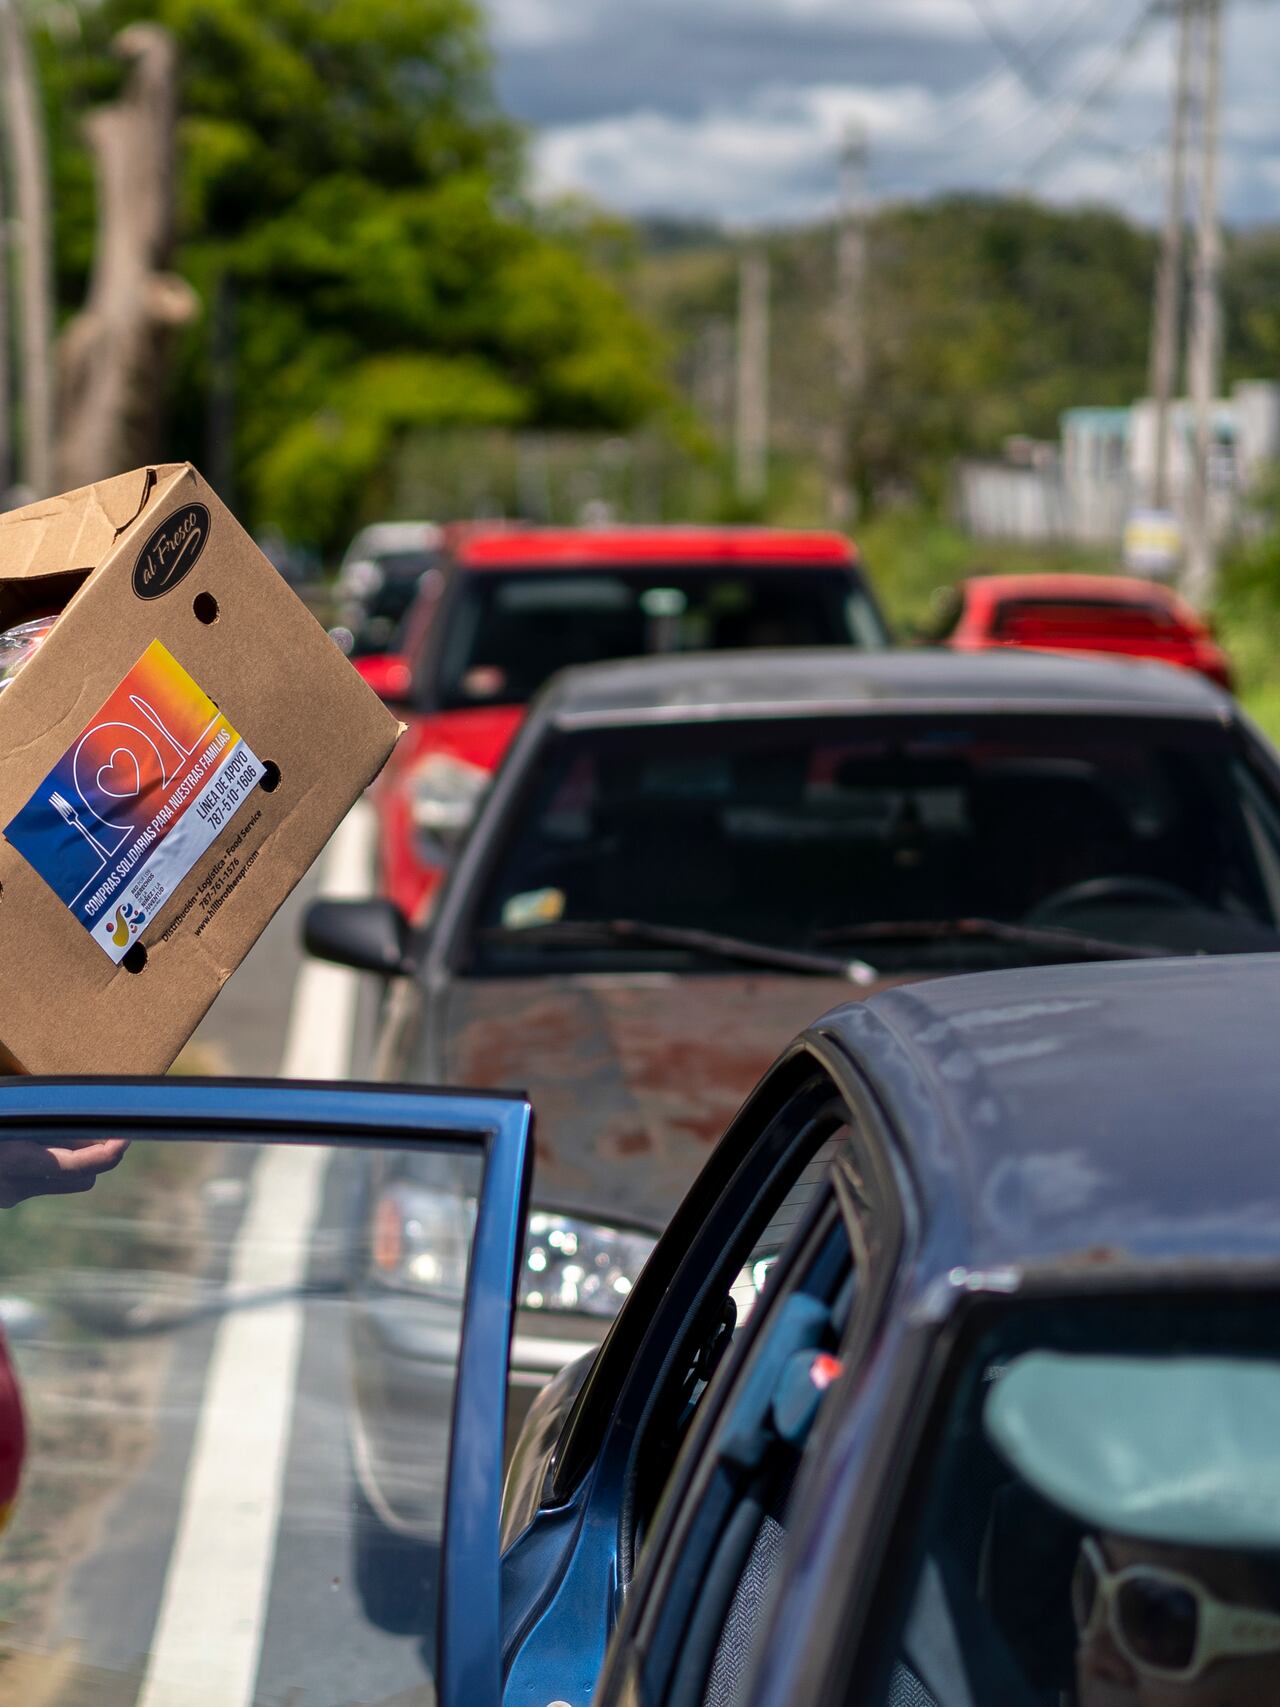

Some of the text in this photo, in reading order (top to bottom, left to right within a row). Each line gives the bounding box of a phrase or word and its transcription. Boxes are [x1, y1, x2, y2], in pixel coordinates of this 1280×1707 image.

[153, 512, 197, 565] Fresco
[196, 750, 248, 820] LÍNEA DE APOYO
[207, 765, 257, 830] 787-510-1606
[84, 728, 231, 917] COMPRAS SOLIDARIAS PARA NUESTRAS FAMILIAS
[134, 872, 154, 899] DERECHOS
[144, 886, 165, 912] JUVENTUD
[162, 810, 262, 943] Distribución Logística Food Service
[194, 850, 260, 938] www.hillbrotherspr.com
[199, 858, 240, 911] 787-761-1576
